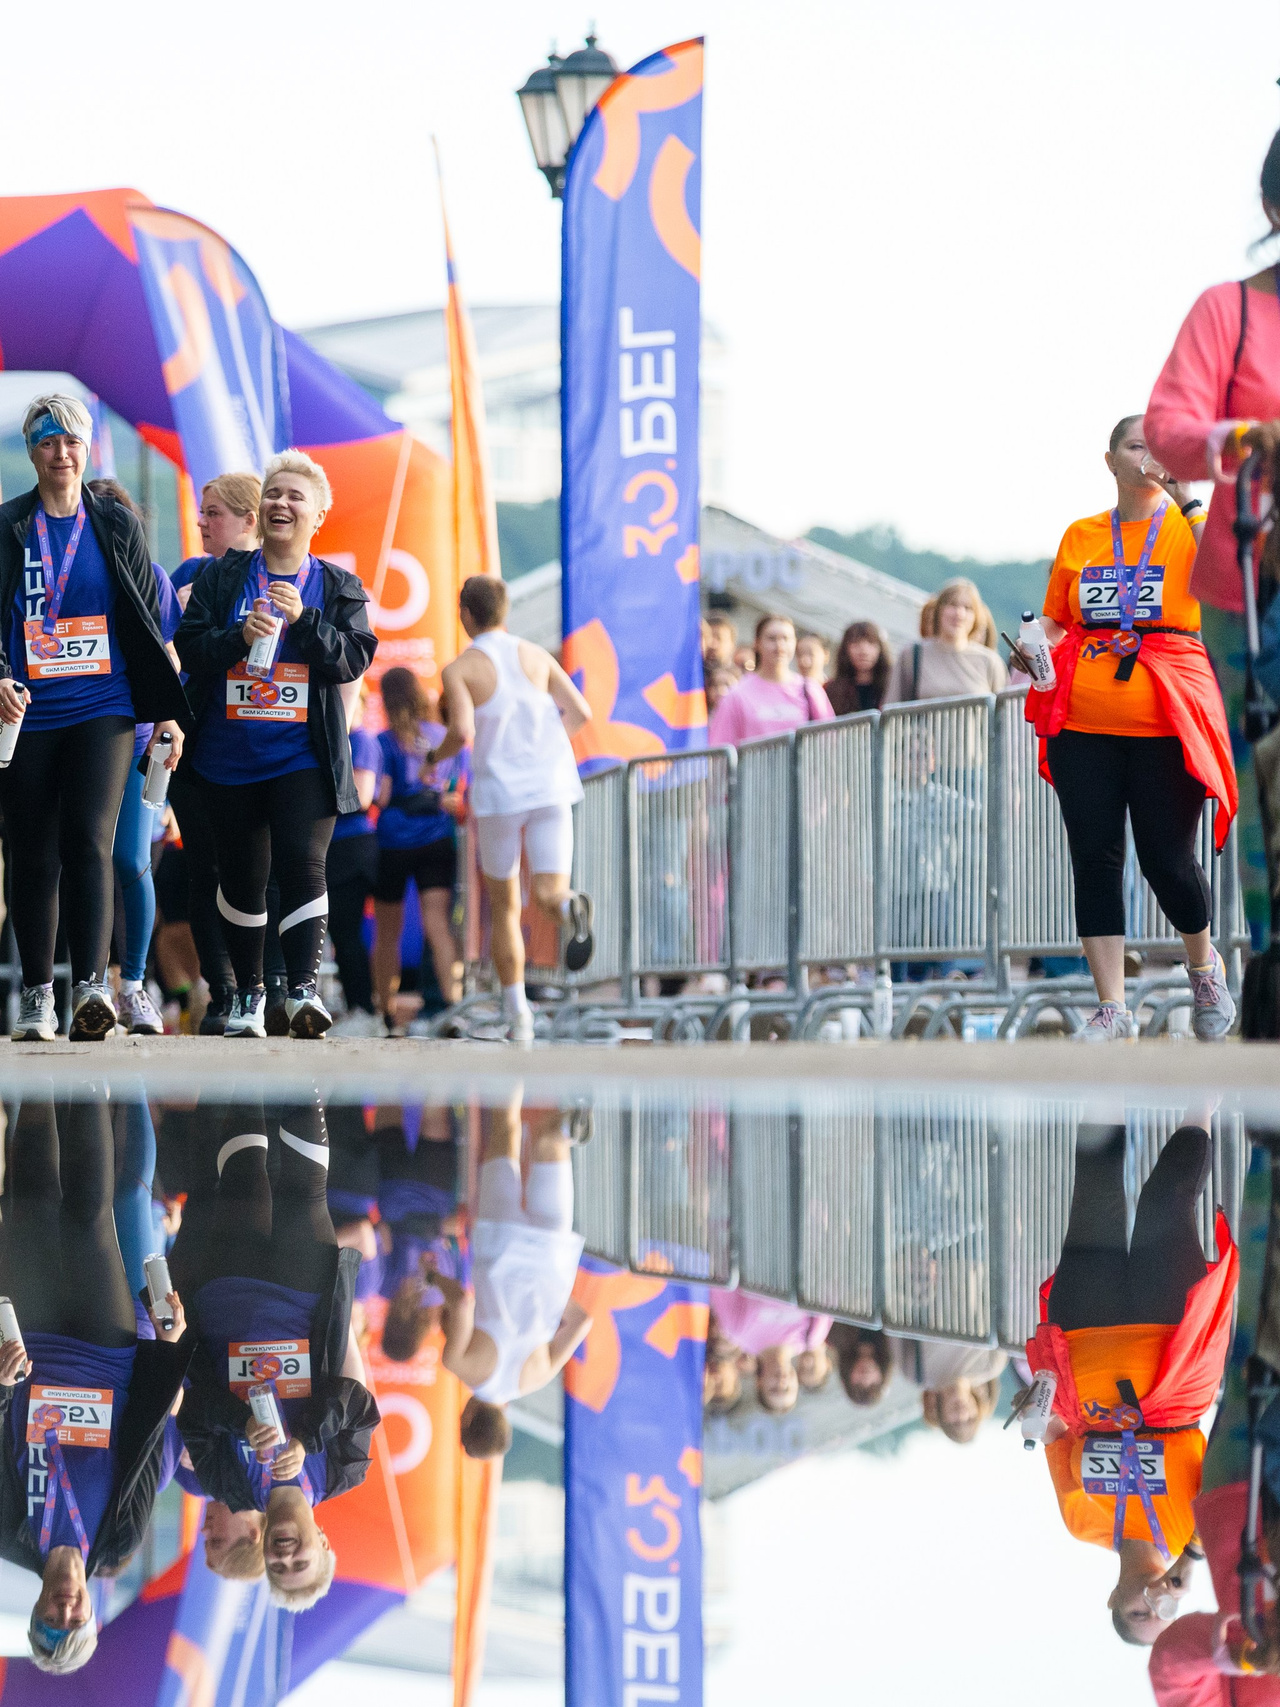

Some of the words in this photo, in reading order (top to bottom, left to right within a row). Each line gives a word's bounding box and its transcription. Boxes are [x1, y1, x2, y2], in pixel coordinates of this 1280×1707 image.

[1087, 585, 1154, 604] 272
[1035, 653, 1046, 681] IPSUM
[1039, 644, 1051, 673] SPORT
